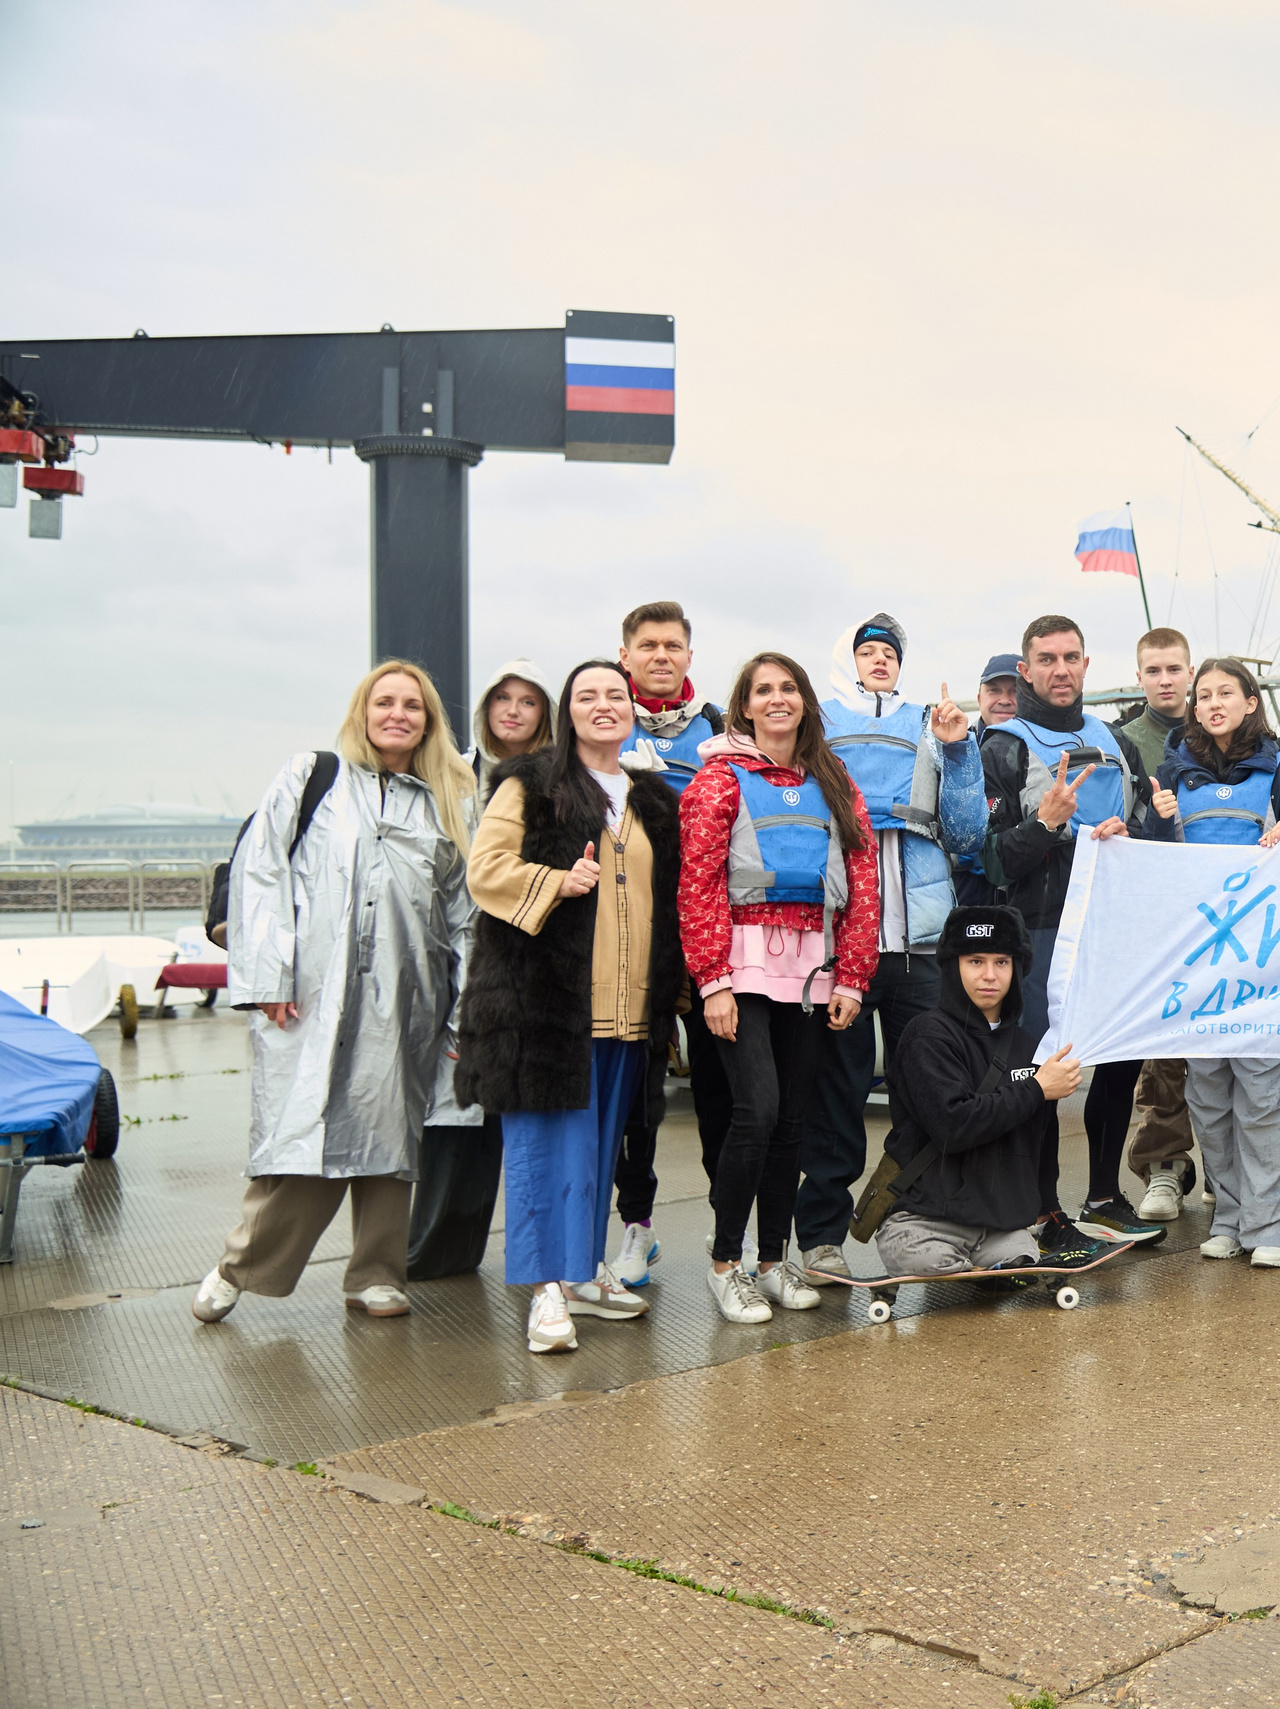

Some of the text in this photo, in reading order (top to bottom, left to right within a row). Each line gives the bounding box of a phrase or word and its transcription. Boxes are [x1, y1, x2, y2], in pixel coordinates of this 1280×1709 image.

[990, 797, 1001, 814] MPX
[966, 924, 995, 937] GST
[1161, 981, 1189, 1020] В
